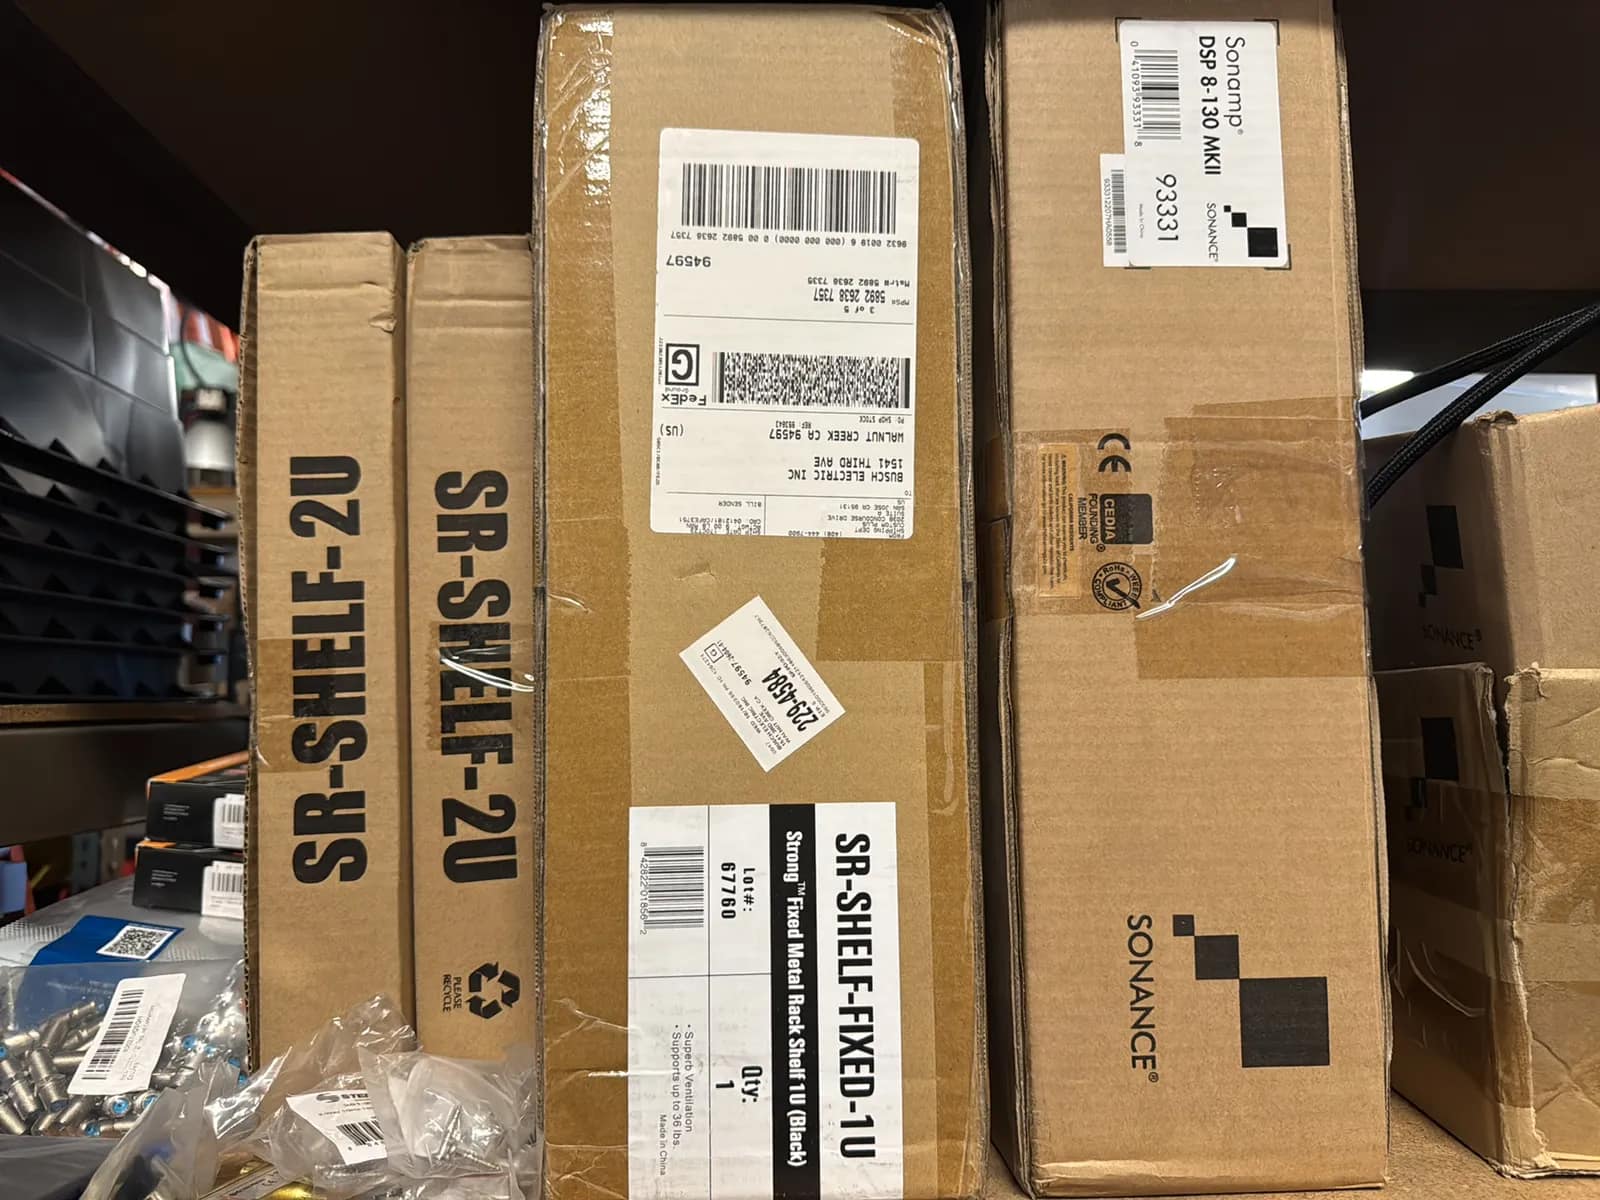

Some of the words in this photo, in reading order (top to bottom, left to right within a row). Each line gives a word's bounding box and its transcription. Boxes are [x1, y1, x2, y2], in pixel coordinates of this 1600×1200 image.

[1199, 36, 1216, 69] DSP
[1200, 76, 1218, 129] 8-130
[1204, 135, 1220, 175] MKII
[1156, 174, 1178, 241] 93331
[666, 255, 712, 267] 94597
[813, 287, 833, 301] 7357
[839, 289, 860, 302] 2638
[864, 289, 886, 303] 5892
[843, 305, 849, 313] 5
[672, 350, 693, 380] G
[661, 393, 707, 405] FedEx
[659, 424, 684, 436] (US)
[769, 428, 801, 439] 94597
[808, 430, 820, 440] CA
[827, 430, 859, 441] CREEK
[865, 431, 904, 442] WALNUT
[814, 456, 833, 467] AVE
[839, 457, 871, 468] THIRD
[879, 458, 903, 469] 1541
[1098, 433, 1131, 472] CE
[788, 469, 807, 480] INC
[813, 470, 865, 481] ELECTRIC
[871, 471, 903, 482] BUSCH
[1078, 498, 1088, 540] MEMBER
[1088, 493, 1098, 544] FOUNDING
[1104, 498, 1116, 541] CEDIA
[290, 455, 368, 884] SR-SHELF-2U
[434, 470, 518, 883] SR-SHELF-2U
[761, 667, 819, 732] 229-4584
[720, 862, 735, 919] 67760
[743, 868, 755, 912] Lot#:
[787, 897, 804, 938] Fixed
[787, 943, 804, 989] Metal
[443, 975, 452, 1012] RECYCLE
[453, 977, 462, 1009] PLEASE
[836, 833, 876, 1159] SR-SHELF-FIXED-1U
[788, 995, 805, 1034] Rack
[670, 1032, 681, 1081] Supports
[683, 1032, 694, 1072] Superb
[788, 1038, 806, 1080] Shelf
[670, 1084, 681, 1097] up
[715, 1081, 734, 1089] 1
[741, 1065, 763, 1103] Qty:
[789, 1084, 806, 1105] 1U
[672, 1099, 681, 1110] to
[684, 1074, 695, 1132] Ventilation
[658, 1115, 667, 1138] Made
[672, 1114, 681, 1128] 36
[659, 1140, 667, 1149] in
[672, 1130, 682, 1149] lbs.
[787, 1110, 808, 1166] (Black)
[659, 1151, 668, 1176] China
